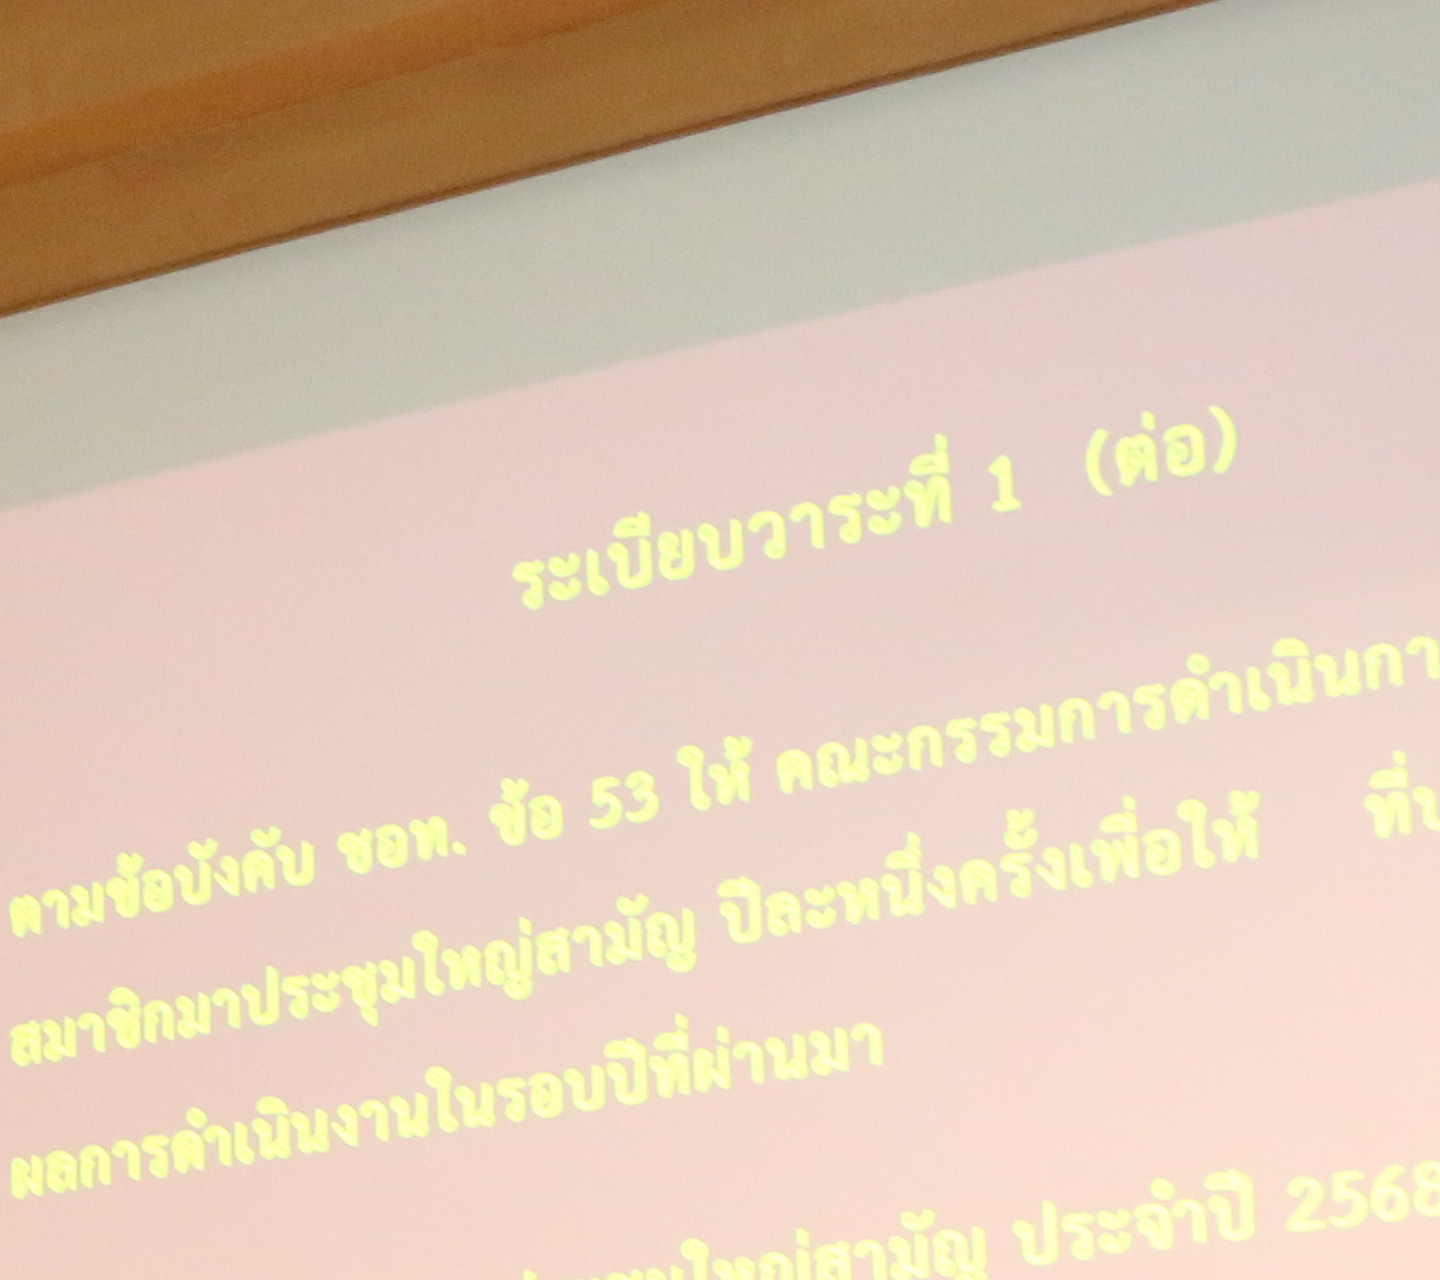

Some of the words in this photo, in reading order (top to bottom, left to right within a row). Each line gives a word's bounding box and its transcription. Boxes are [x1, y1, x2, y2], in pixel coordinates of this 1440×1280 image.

[513, 434, 953, 610] ระเบียบวาระที่
[988, 456, 1022, 512] 1
[1085, 405, 1238, 496] (ต่อ)
[9, 826, 316, 936] ตามข้อบังคับ
[489, 778, 564, 846] ข้อ
[589, 770, 660, 829] 53
[677, 736, 753, 811] ให้
[1013, 1170, 1256, 1265] ประจำปี
